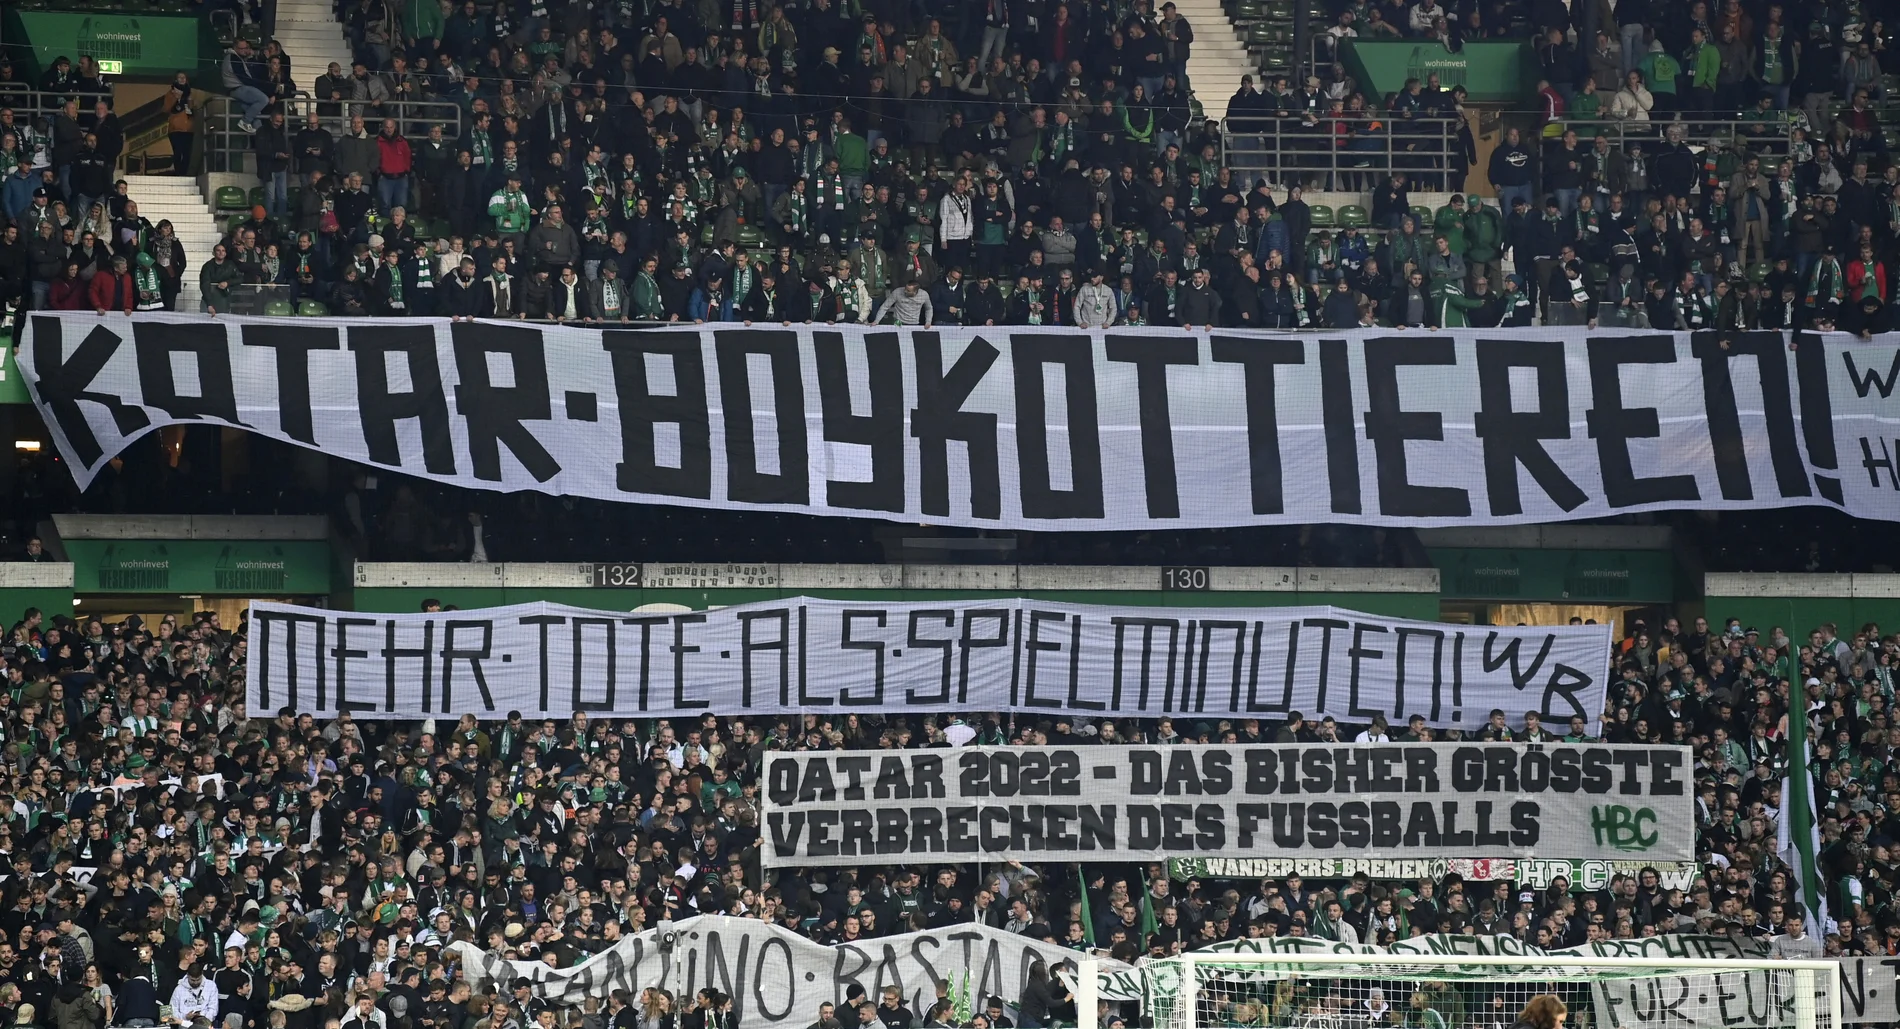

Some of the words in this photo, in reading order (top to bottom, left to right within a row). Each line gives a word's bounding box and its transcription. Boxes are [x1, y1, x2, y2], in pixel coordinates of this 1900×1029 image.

[97, 32, 141, 41] wohninvest
[1859, 437, 1900, 491] H
[120, 560, 169, 569] wohninvest
[236, 561, 284, 569] wohninvest
[1474, 567, 1519, 576] wohninvest
[1583, 569, 1629, 578] wohninvest
[598, 566, 638, 586] 132
[1166, 569, 1206, 588] 130
[253, 610, 495, 713] MEHR
[520, 614, 709, 711] TOTE
[737, 606, 886, 708] ALS
[767, 753, 945, 807] QATAR
[959, 750, 1081, 798] 2022
[1129, 748, 1231, 796] DAS
[1246, 748, 1440, 794] BISHER
[1451, 743, 1684, 795] GRÖSSTE
[767, 804, 1117, 857] VERBRECHEN
[1128, 804, 1226, 850] DES
[1237, 802, 1541, 850] FUSSBALLS
[1591, 804, 1658, 847] HBC
[1205, 858, 1335, 877] WANDERERS
[1341, 859, 1431, 879] BREMEN
